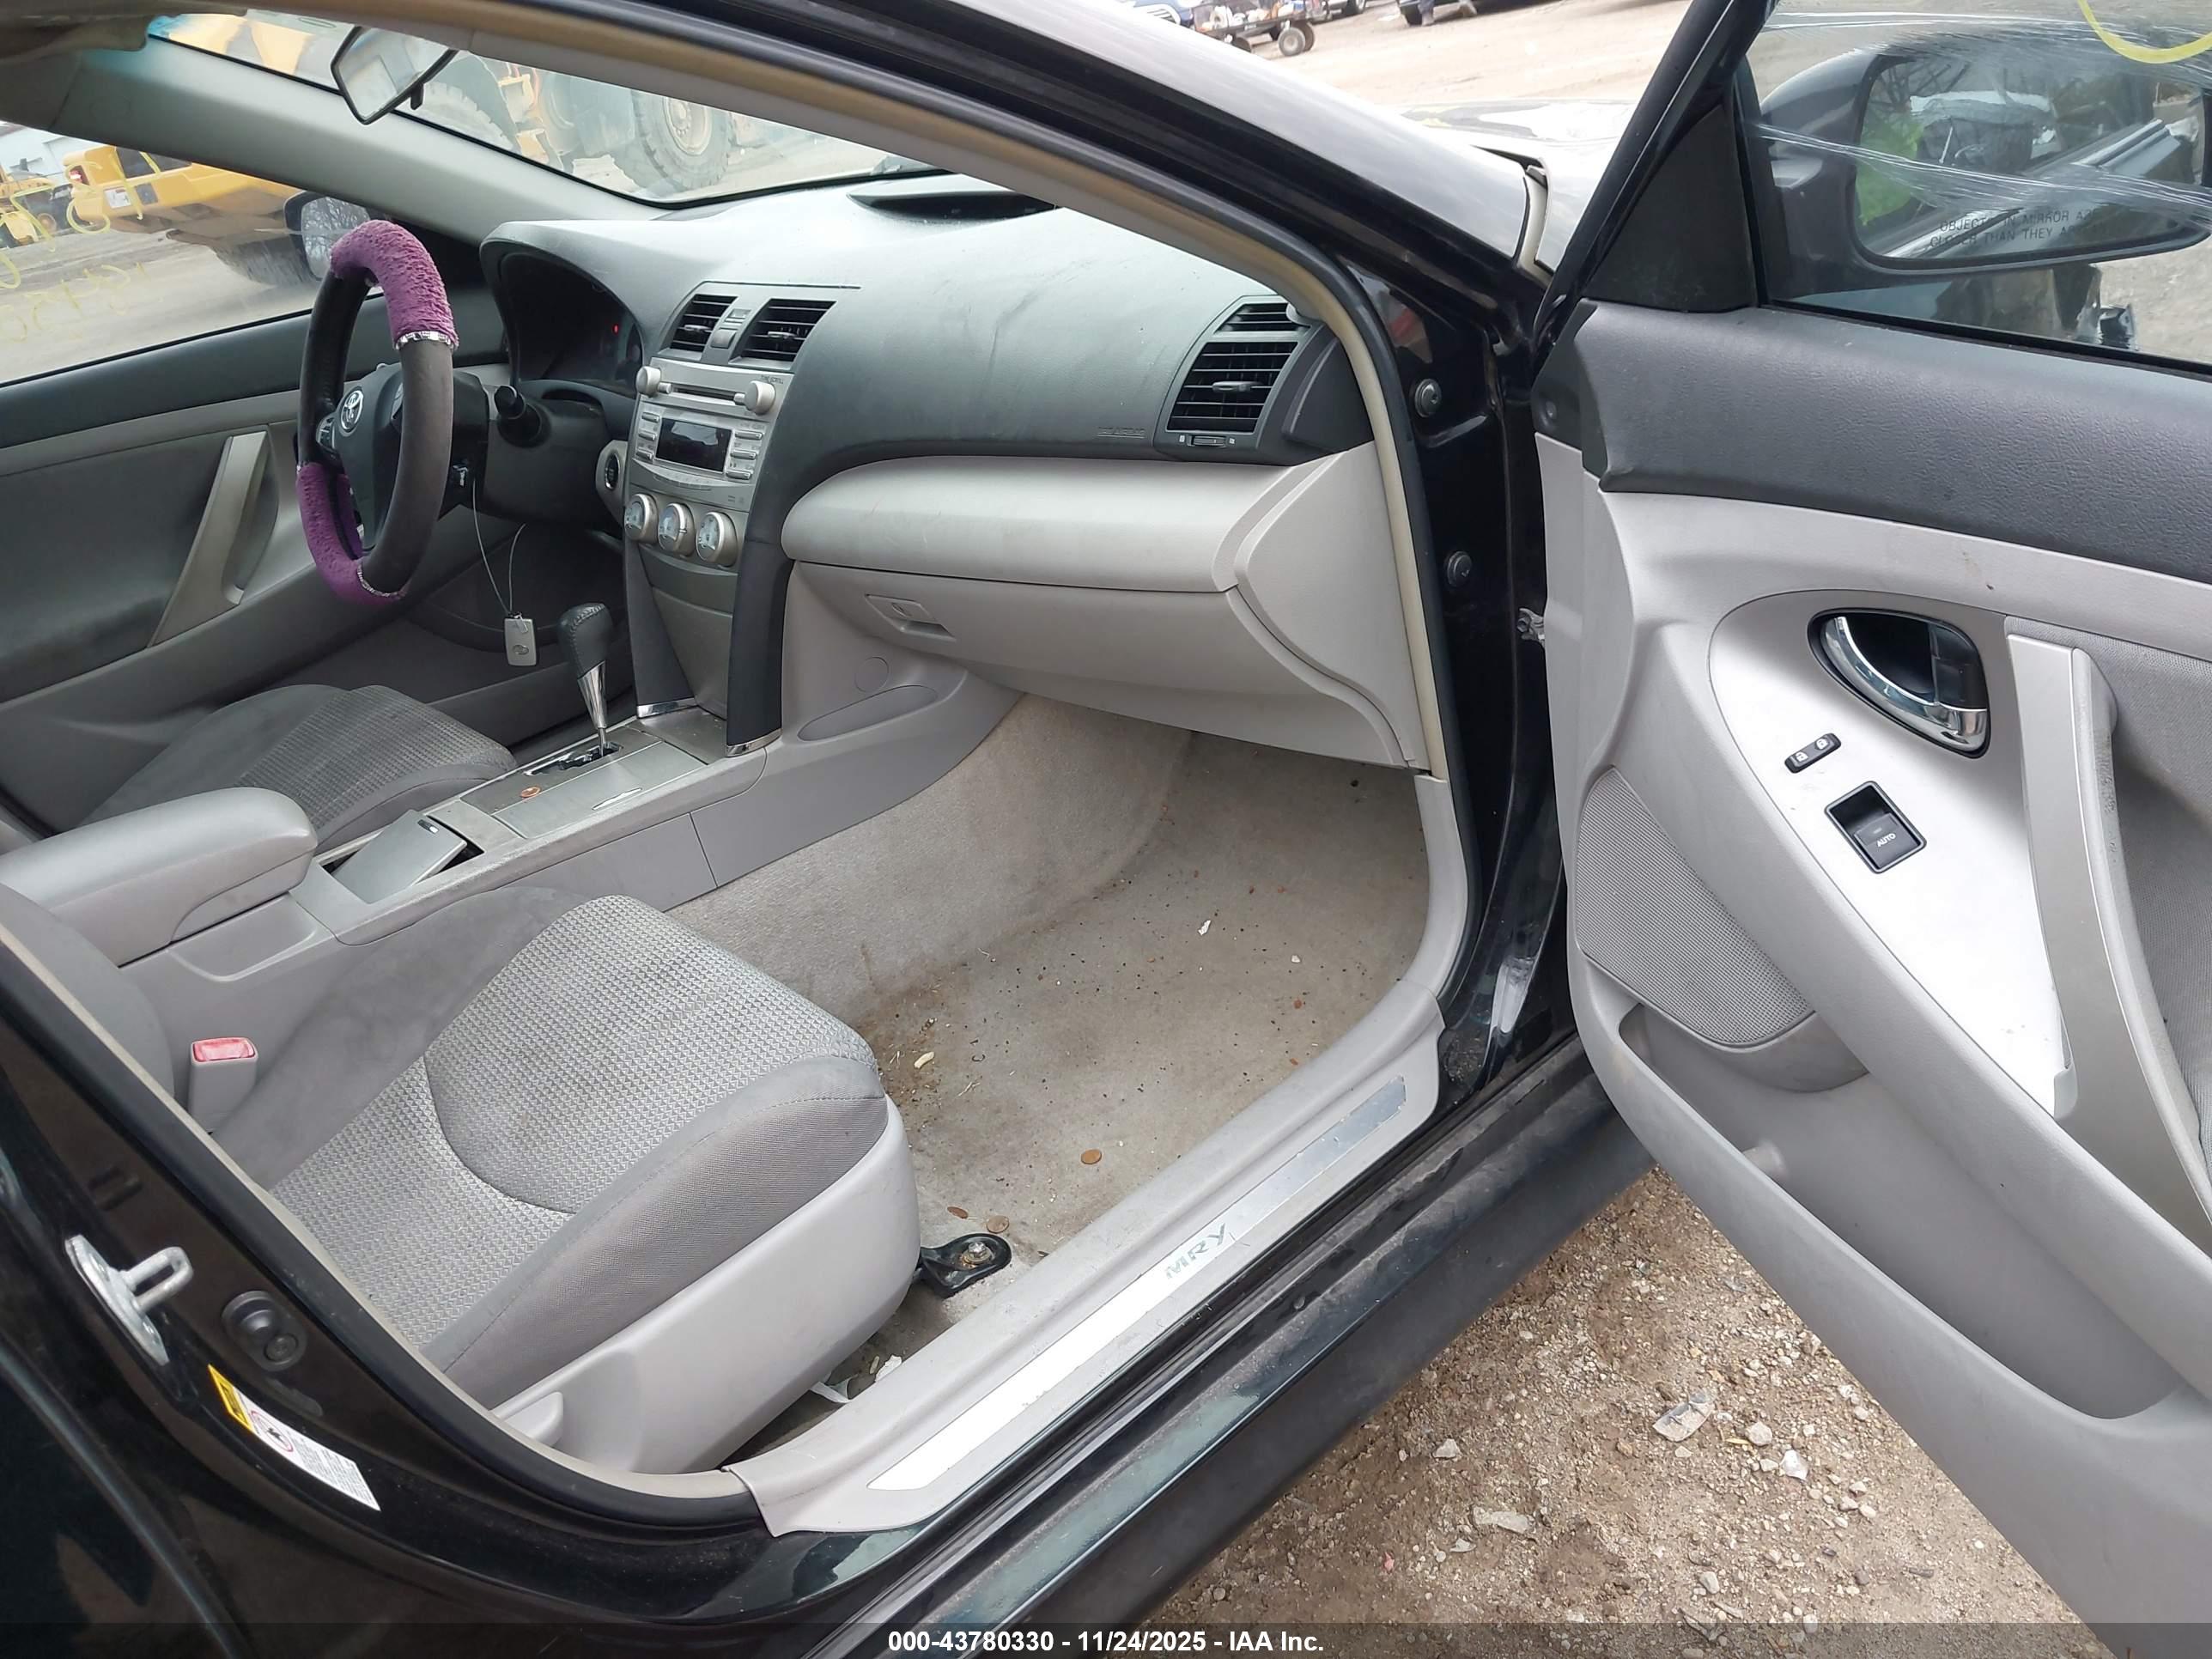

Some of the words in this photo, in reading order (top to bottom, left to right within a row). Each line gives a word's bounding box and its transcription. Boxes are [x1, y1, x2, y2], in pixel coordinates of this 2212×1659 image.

[1941, 216, 1994, 232] OBJECT
[2024, 210, 2069, 224] MIRROR
[1984, 231, 2015, 244] THAN
[2022, 228, 2053, 240] THEY
[1876, 833, 1896, 847] AUTO
